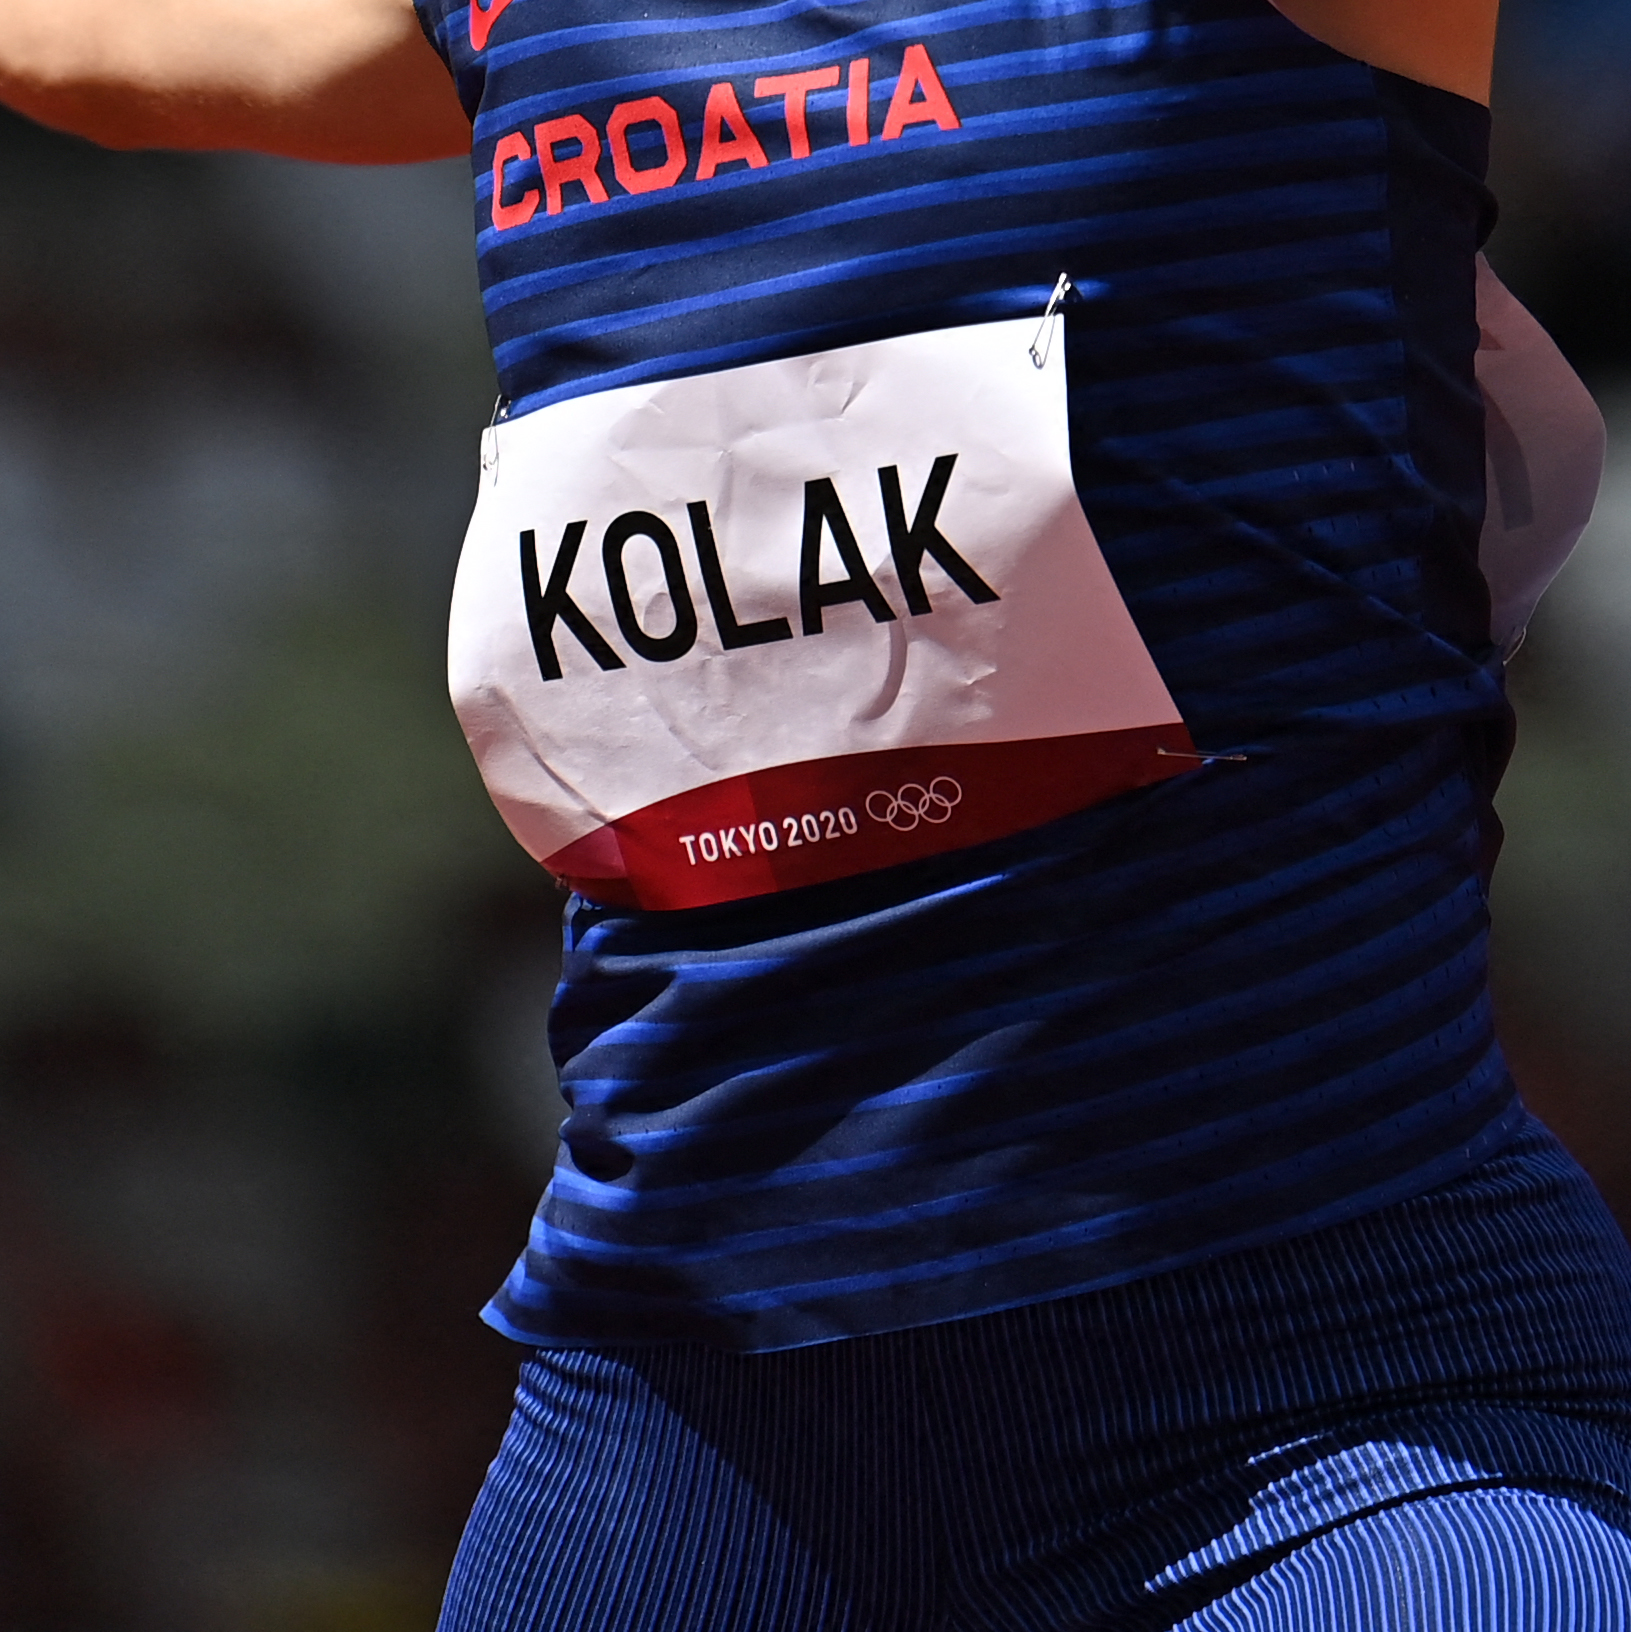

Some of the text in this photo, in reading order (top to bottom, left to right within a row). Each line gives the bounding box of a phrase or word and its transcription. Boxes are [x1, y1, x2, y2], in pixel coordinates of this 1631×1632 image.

[491, 43, 962, 231] CROATIA
[519, 453, 1001, 682] KOLAK
[678, 806, 858, 867] TOKYO 2020
